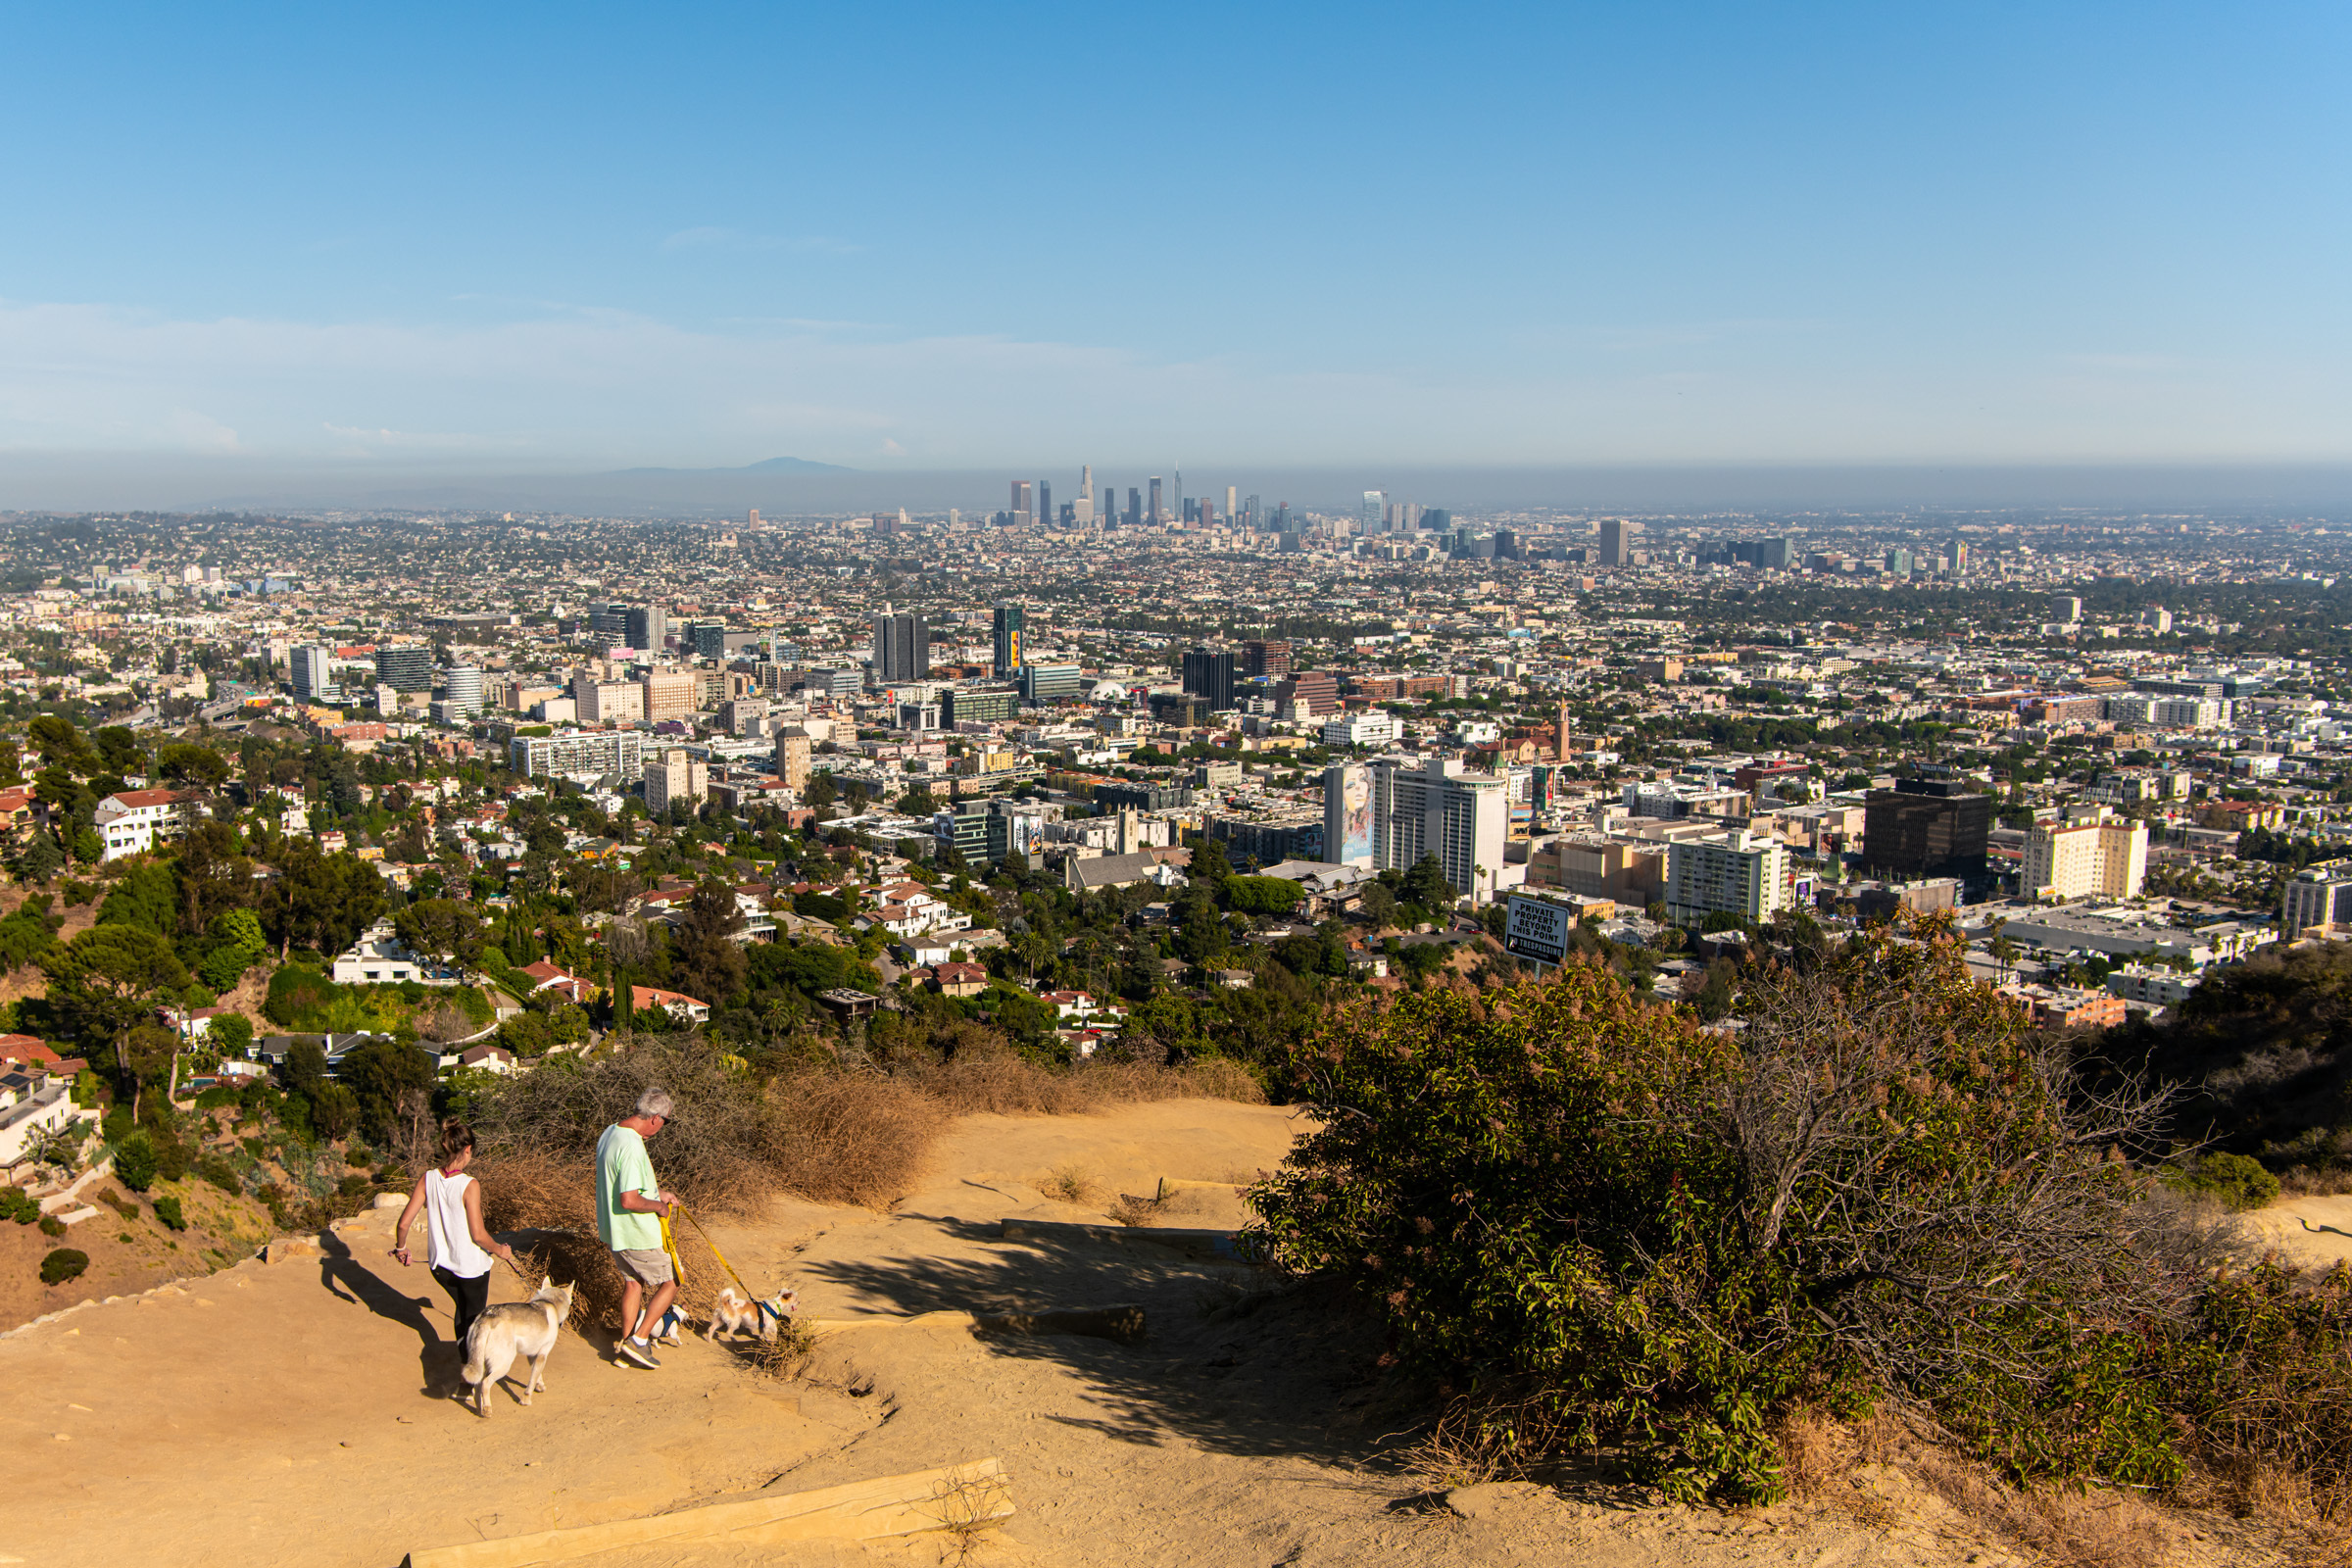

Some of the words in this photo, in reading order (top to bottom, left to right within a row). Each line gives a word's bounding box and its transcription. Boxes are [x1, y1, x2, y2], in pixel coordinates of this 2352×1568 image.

[1515, 910, 1558, 927] PROPERTY
[1520, 904, 1554, 918] PRIVATE
[1513, 925, 1531, 935] THIS
[1534, 930, 1558, 943] POINT
[1520, 919, 1552, 933] BEYOND
[1520, 939, 1562, 956] TRESPASSING
